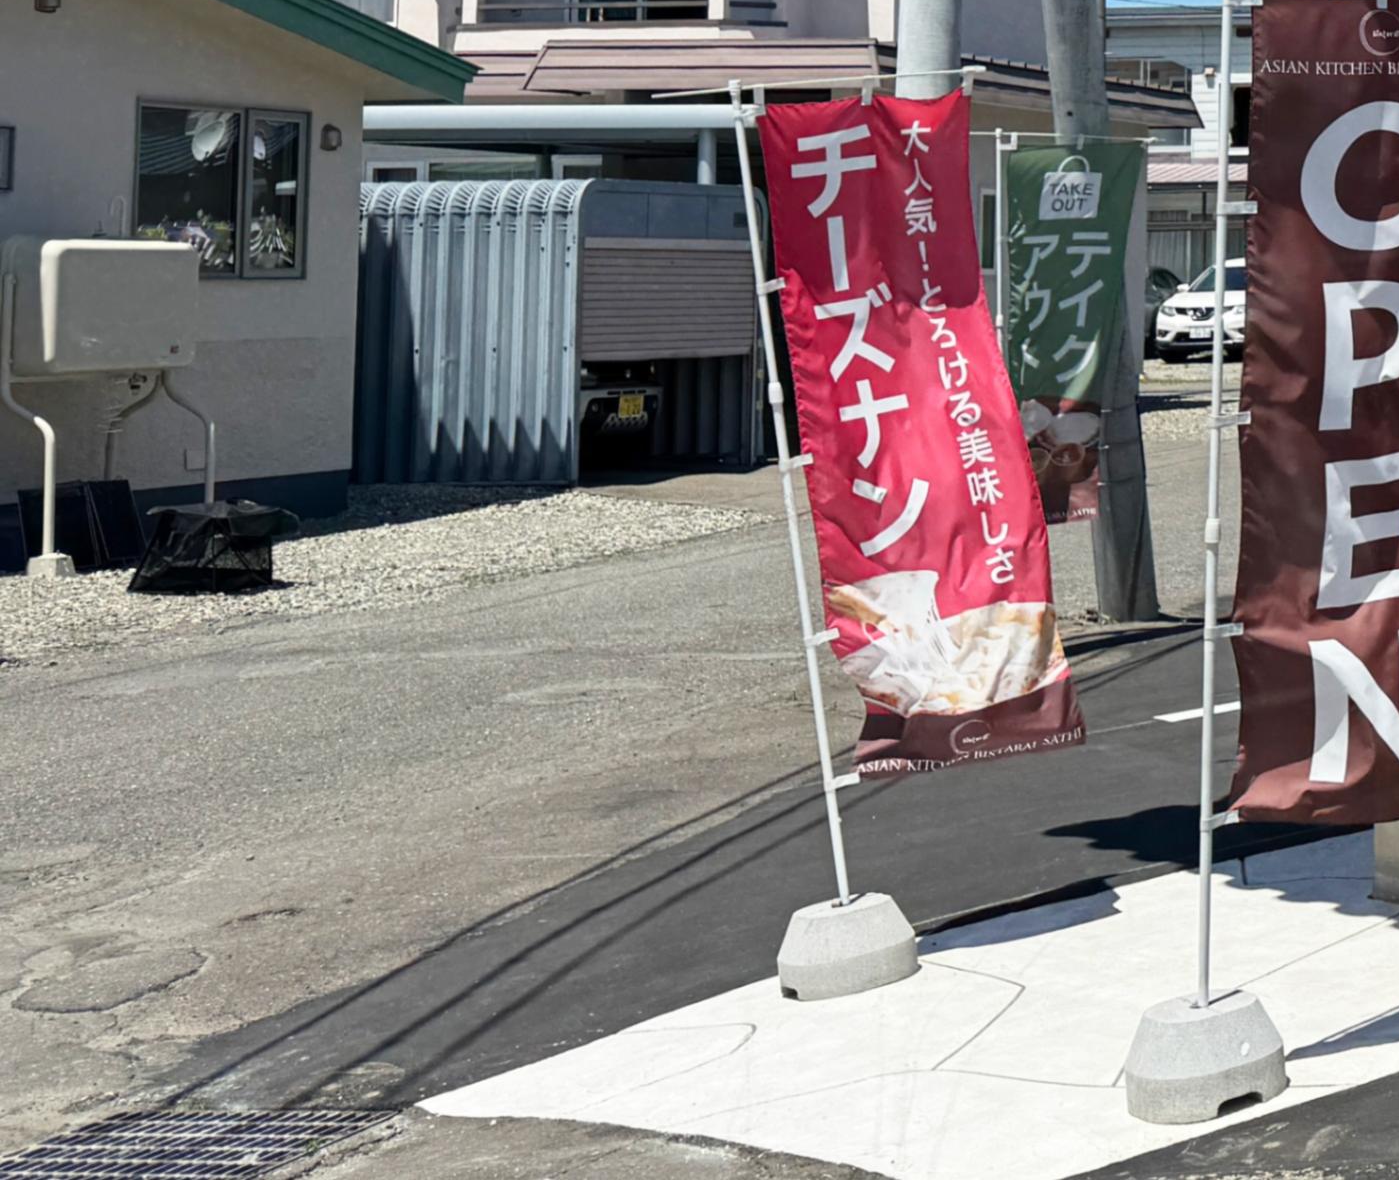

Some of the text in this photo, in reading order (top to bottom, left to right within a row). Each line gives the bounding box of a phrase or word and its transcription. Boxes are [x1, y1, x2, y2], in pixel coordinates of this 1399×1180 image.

[1260, 59, 1309, 75] ASIAN
[1315, 61, 1384, 76] KITCHEN
[1050, 182, 1094, 197] TAKE
[1051, 197, 1088, 213] OUT
[1052, 231, 1112, 384] テイク
[790, 123, 931, 558] チーズナン
[857, 758, 901, 773] ASIAN
